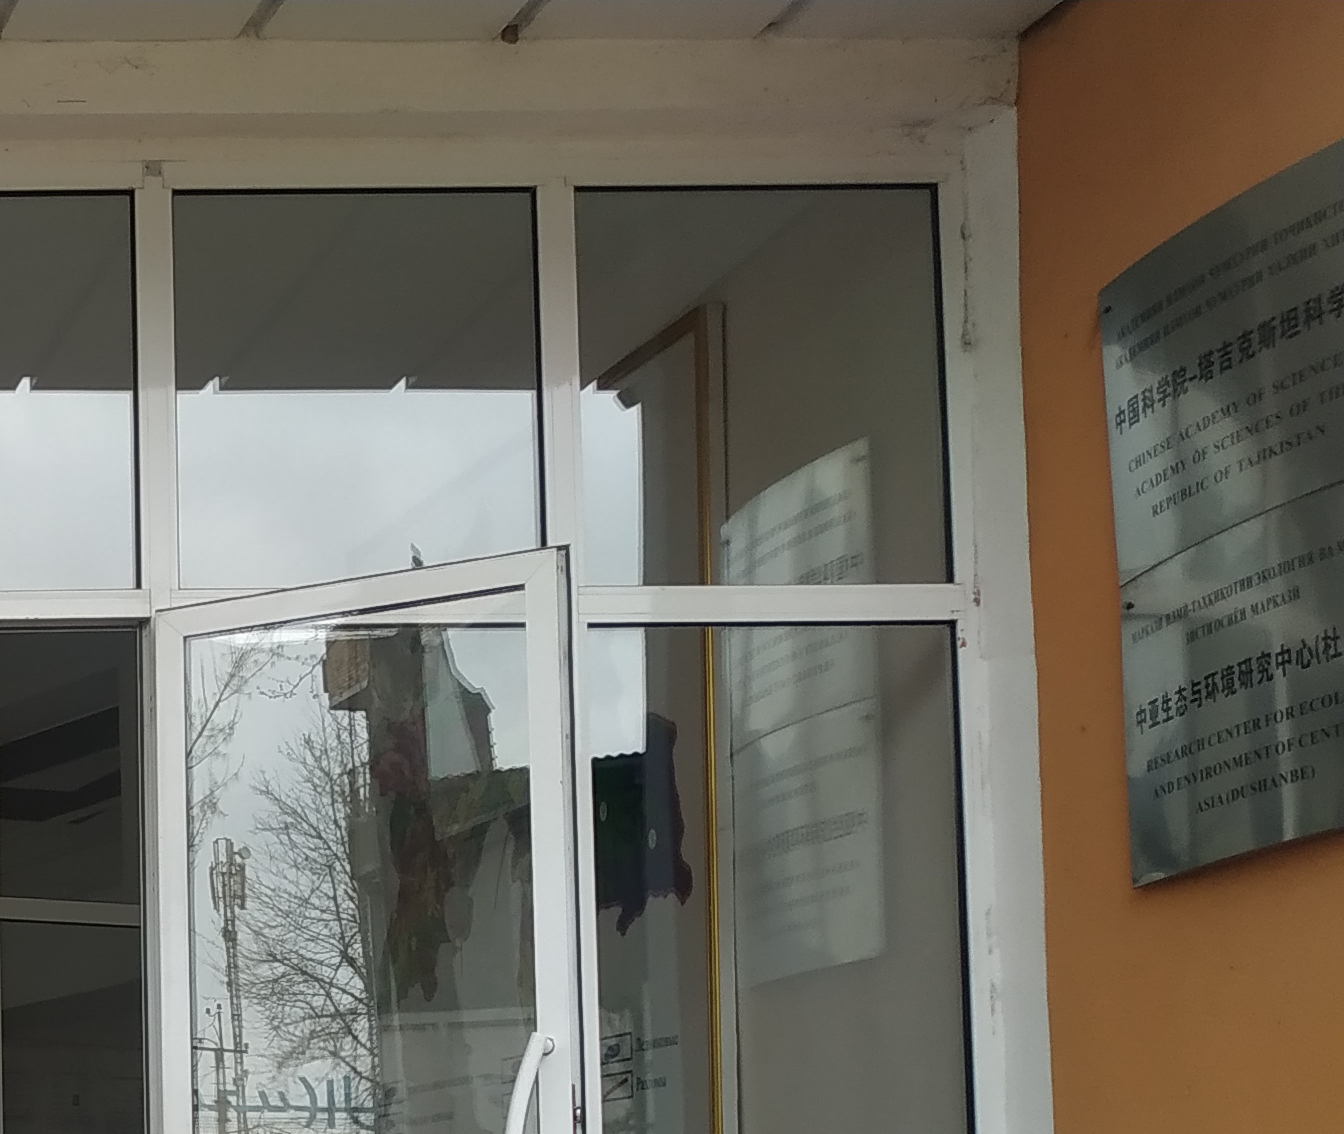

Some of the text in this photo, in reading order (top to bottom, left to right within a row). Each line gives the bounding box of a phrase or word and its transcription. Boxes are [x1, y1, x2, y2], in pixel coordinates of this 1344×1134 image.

[1128, 436, 1177, 473] CHINESE
[1177, 401, 1240, 448] ACADEMY
[1246, 387, 1266, 407] OF
[1134, 459, 1187, 498] ACADEMY
[1191, 446, 1210, 465] OF
[1213, 409, 1283, 455] SCIENCES
[1288, 397, 1312, 418] OF
[1151, 421, 1327, 518] REPUBLIC OF TAJIKISTAN
[1146, 737, 1206, 773] RESEARCH
[1208, 717, 1261, 747] CENTER
[1264, 705, 1296, 728] FOR
[1153, 780, 1175, 799] AND
[1176, 744, 1272, 791] ENVIRONMENT
[1274, 738, 1296, 756] OF
[1196, 764, 1316, 814] ASIA (DUSHANBE)
